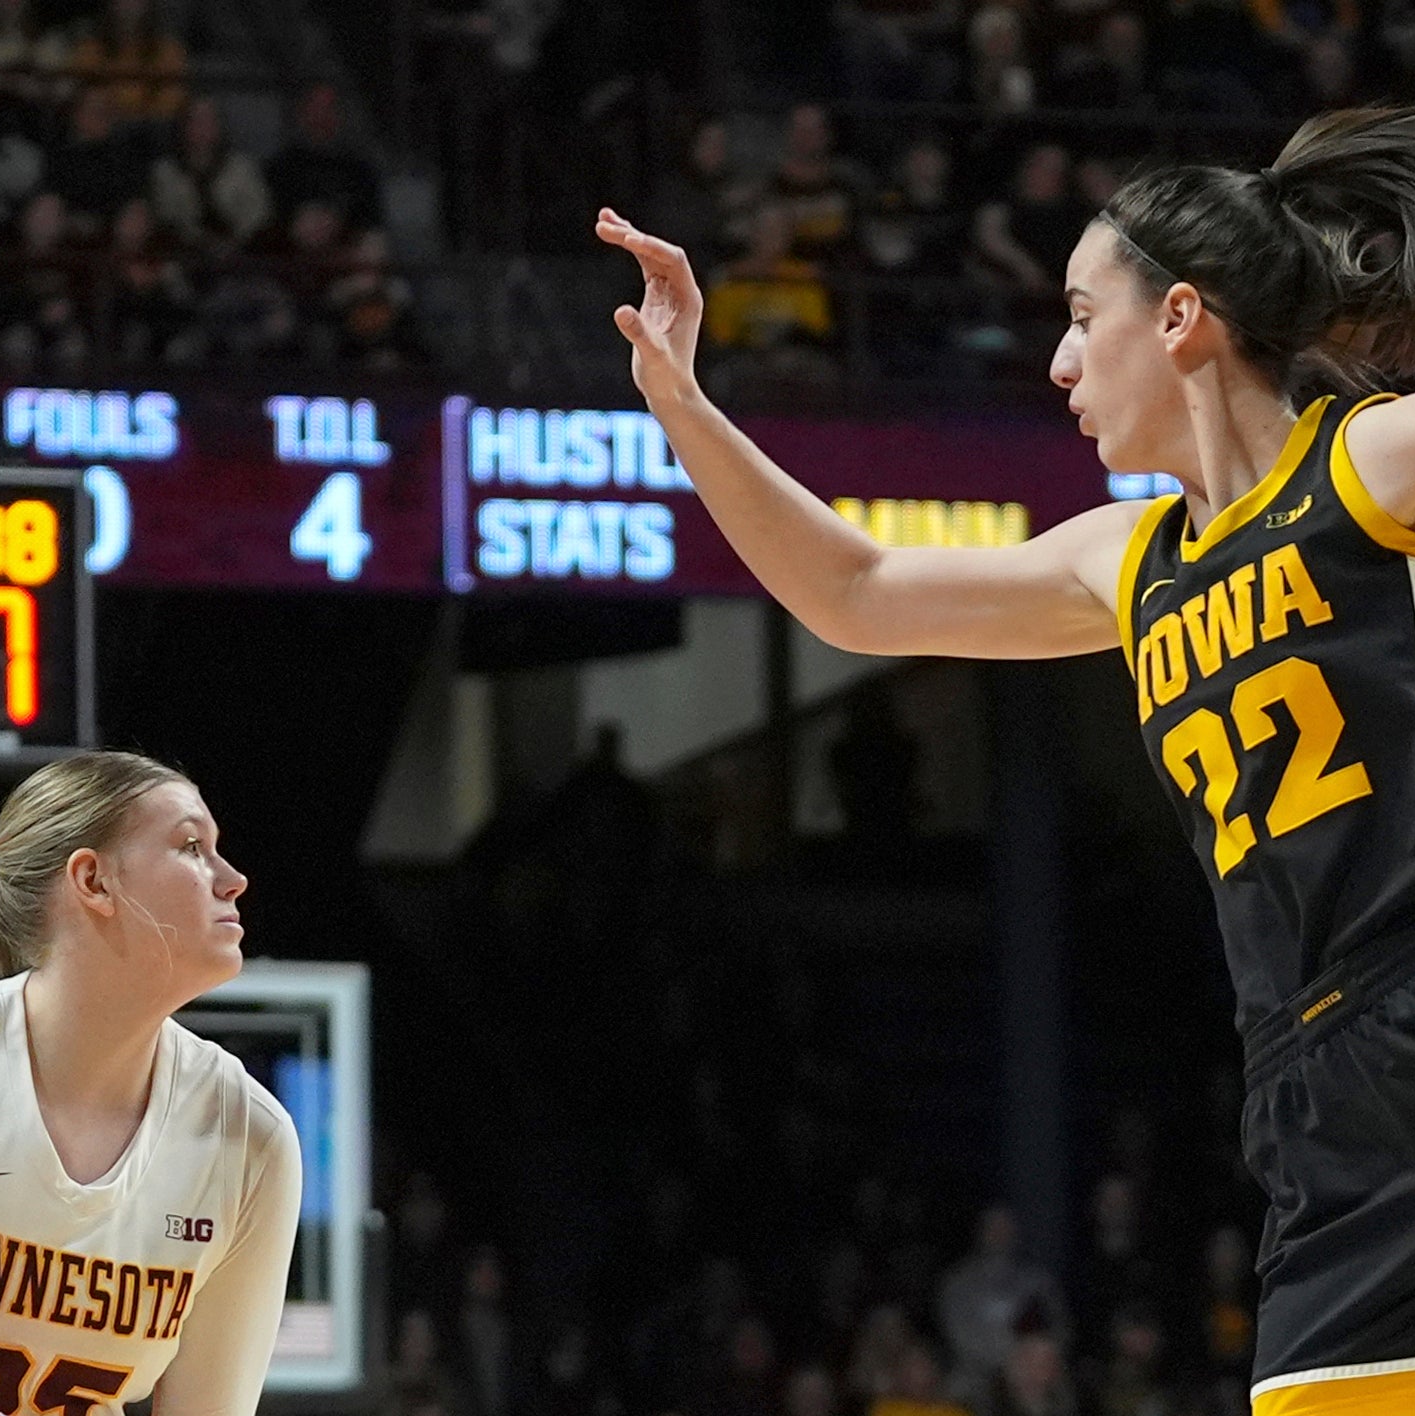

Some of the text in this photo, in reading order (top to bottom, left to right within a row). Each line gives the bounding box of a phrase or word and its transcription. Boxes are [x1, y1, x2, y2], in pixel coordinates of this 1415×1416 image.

[3, 386, 180, 460] FOULS
[468, 406, 698, 492] HUSTL
[289, 470, 374, 582] 4
[477, 498, 676, 582] STATS
[1137, 541, 1334, 727] IOWA
[1161, 656, 1373, 881] 22
